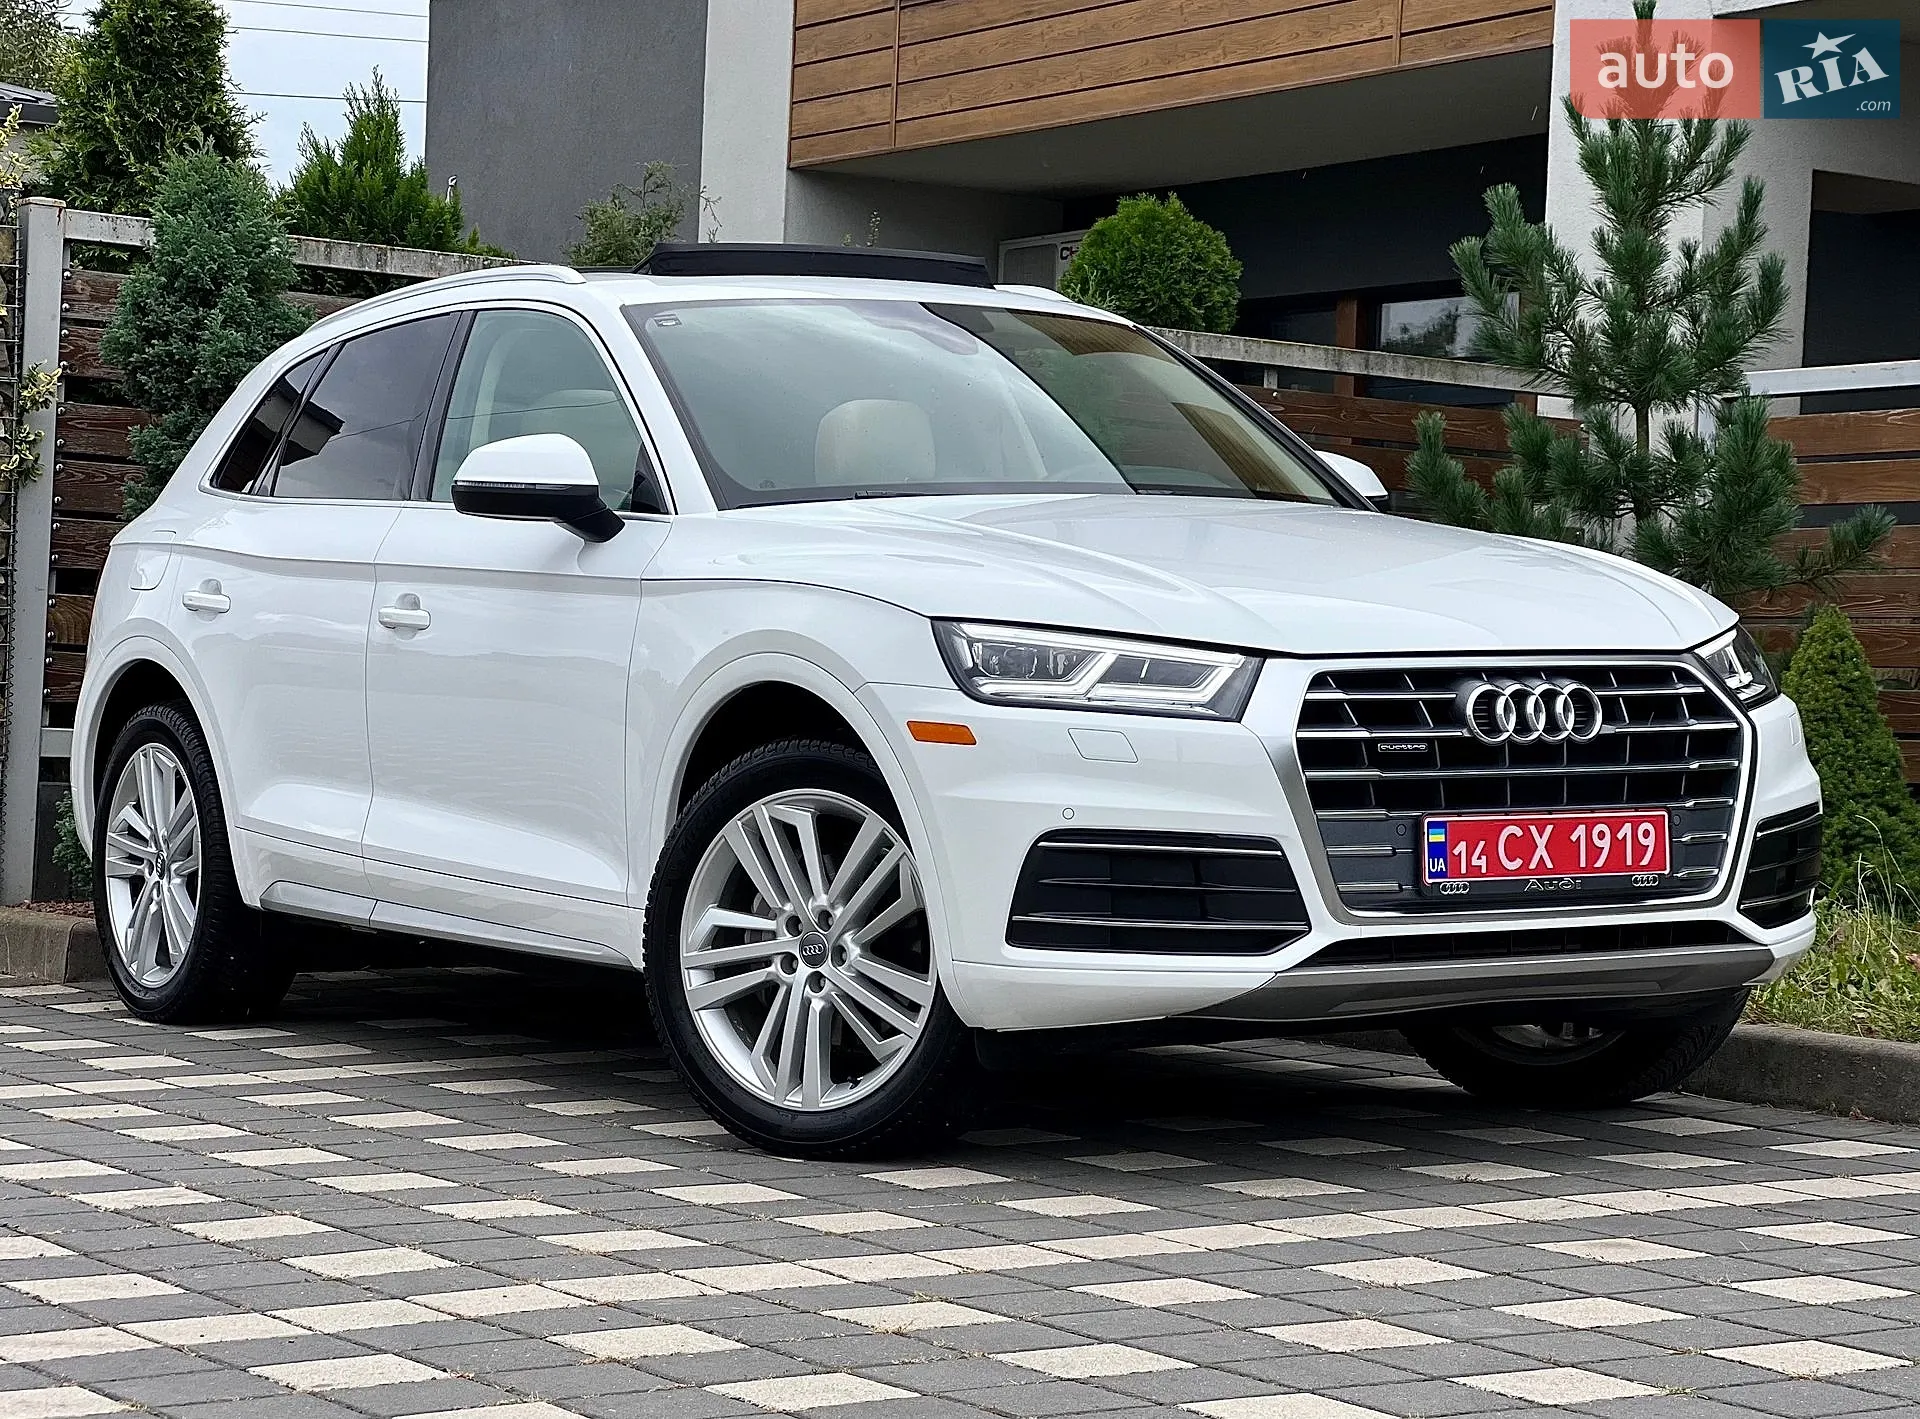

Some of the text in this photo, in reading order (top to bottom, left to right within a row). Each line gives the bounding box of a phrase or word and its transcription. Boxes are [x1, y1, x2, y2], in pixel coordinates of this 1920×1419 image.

[1452, 822, 1656, 874] 14 CX 1919
[1429, 857, 1446, 873] UA
[1524, 878, 1582, 892] Audi
